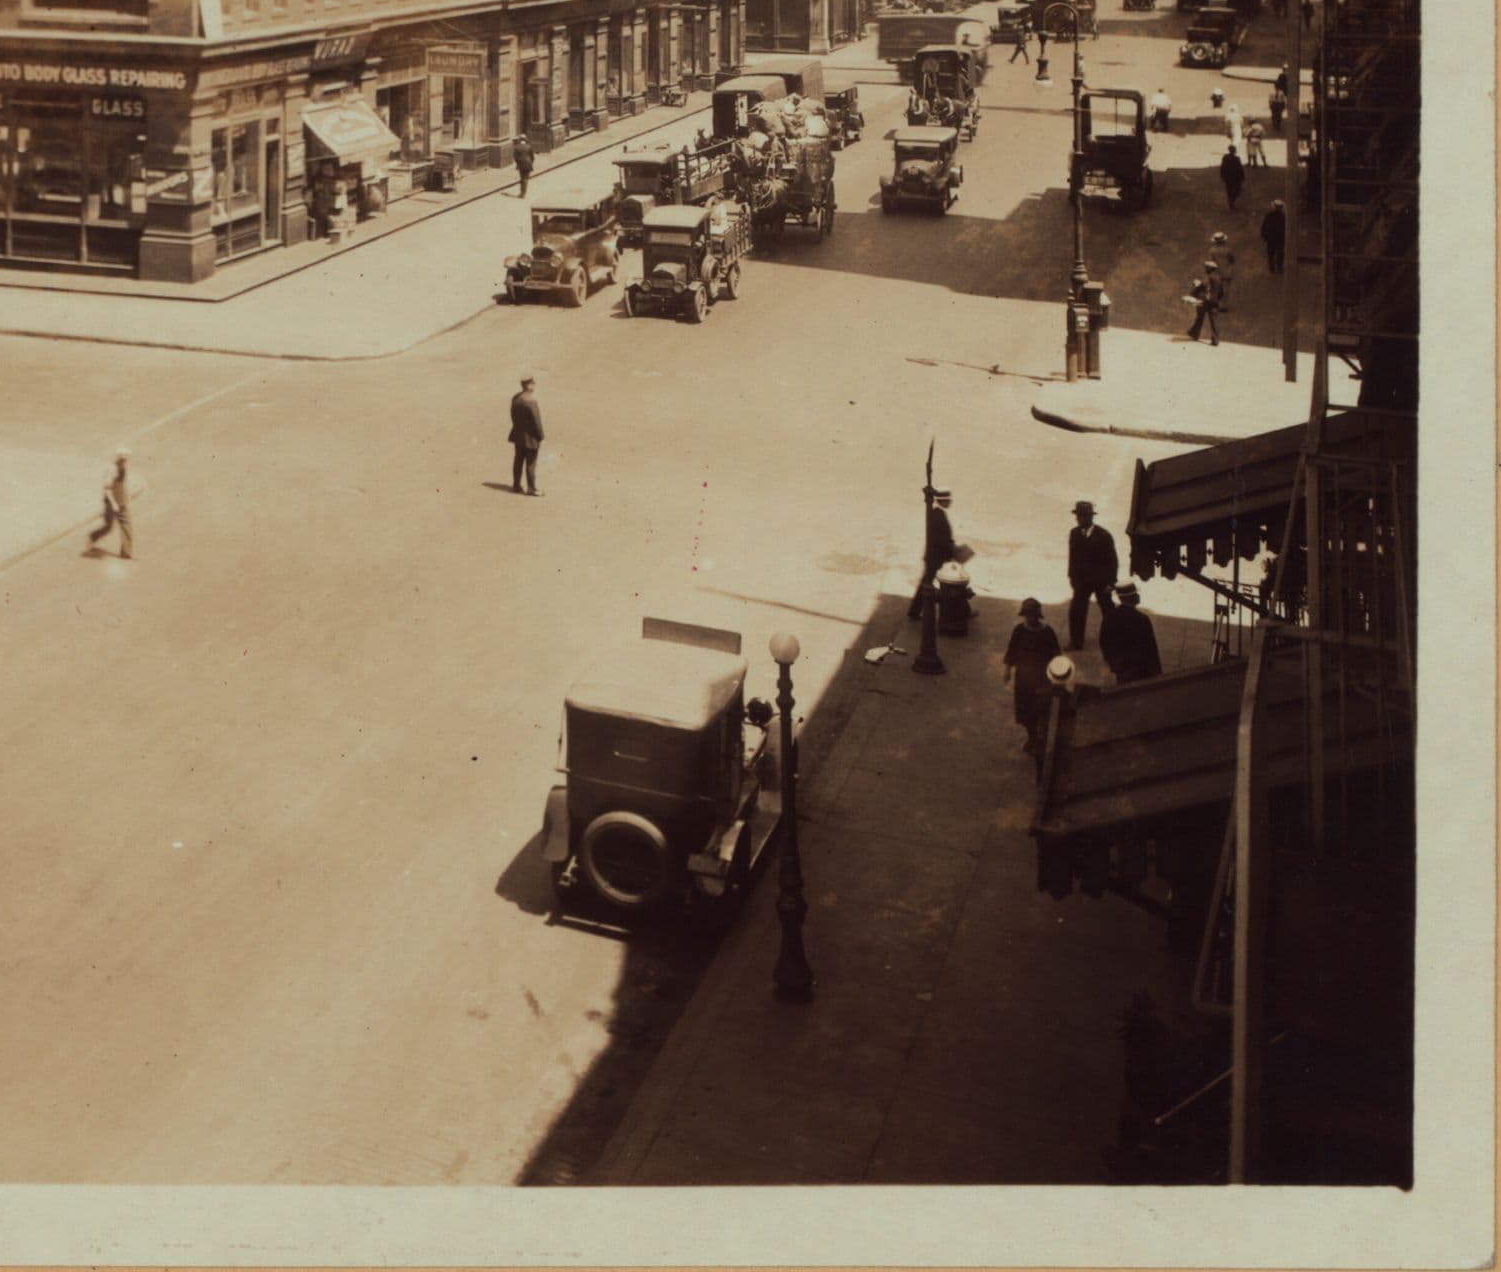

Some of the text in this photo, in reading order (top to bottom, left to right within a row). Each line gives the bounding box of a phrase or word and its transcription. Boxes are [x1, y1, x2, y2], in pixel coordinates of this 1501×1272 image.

[23, 63, 62, 83] BODY
[62, 64, 107, 86] GLASS
[109, 68, 187, 90] REPAIRING
[92, 98, 145, 118] GLASS
